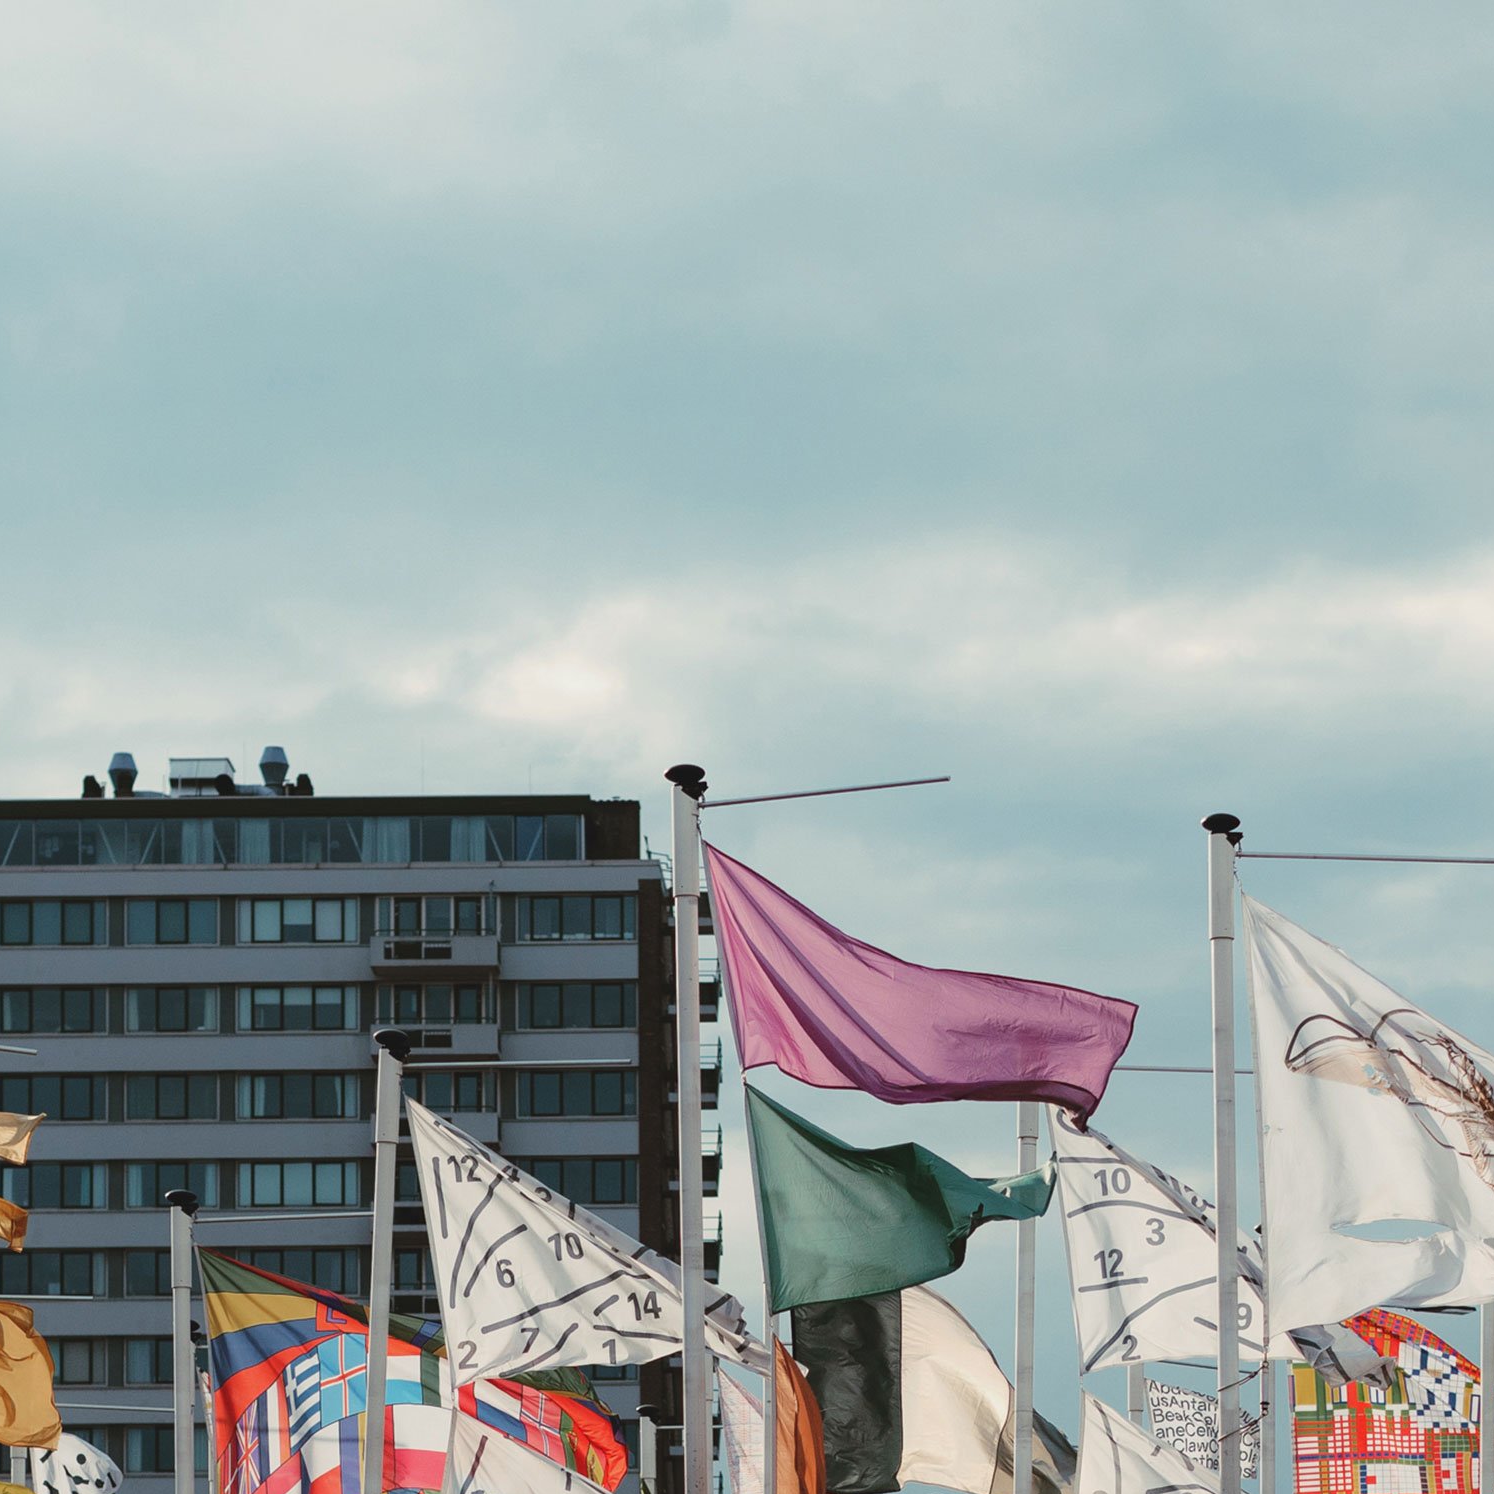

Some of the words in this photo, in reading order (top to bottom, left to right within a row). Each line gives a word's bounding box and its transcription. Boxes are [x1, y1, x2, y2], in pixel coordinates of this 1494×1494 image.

[447, 1155, 481, 1183] 12
[1094, 1168, 1131, 1196] 10
[1145, 1218, 1166, 1246] 3
[548, 1232, 584, 1261] 10
[496, 1259, 515, 1288] 6
[1094, 1249, 1124, 1279] 12
[628, 1291, 662, 1321] 14
[1236, 1303, 1252, 1330] 9
[520, 1328, 539, 1353] 7
[602, 1339, 617, 1364] 1
[1121, 1335, 1141, 1361] 2
[458, 1341, 478, 1369] 2
